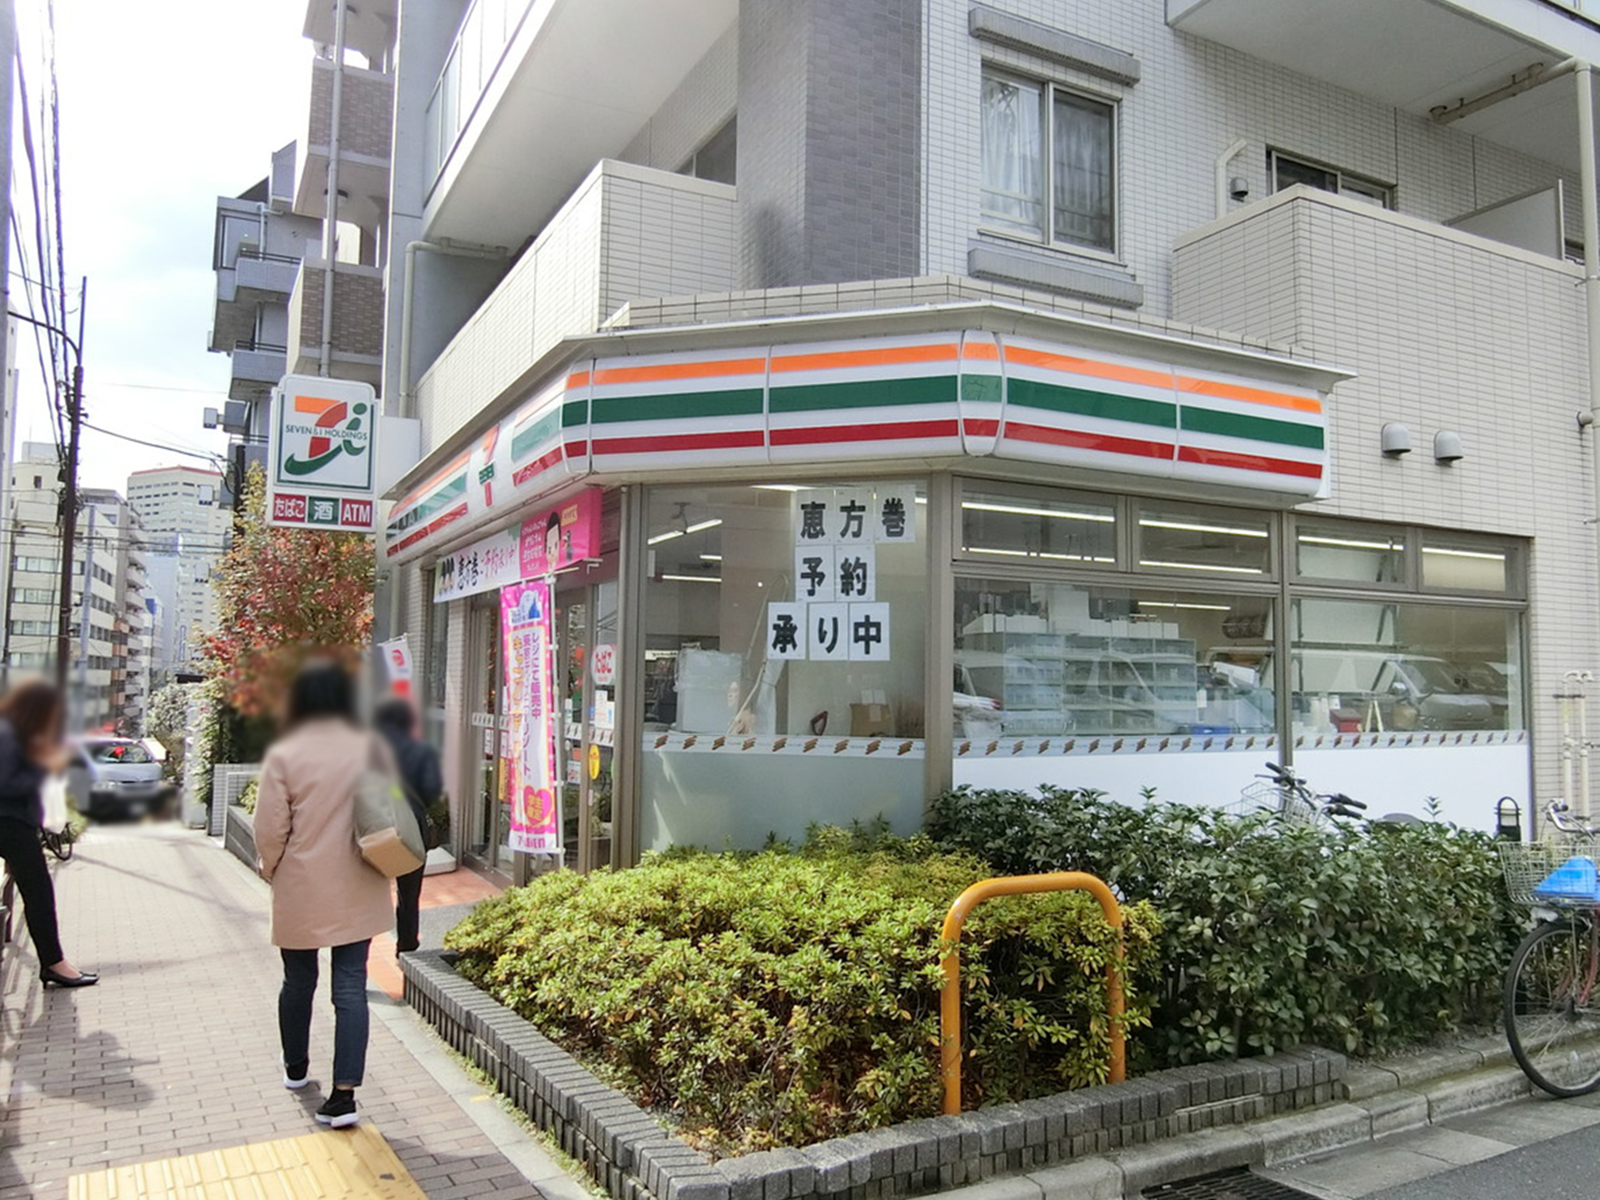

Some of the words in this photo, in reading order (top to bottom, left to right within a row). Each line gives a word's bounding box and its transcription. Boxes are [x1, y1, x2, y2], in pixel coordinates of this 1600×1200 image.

[285, 424, 312, 436] SEVEN
[324, 429, 368, 441] HOLDINGS
[274, 499, 305, 519] たばこ
[313, 501, 334, 521] 酒
[343, 503, 370, 523] ATM
[801, 497, 906, 540] 恵方巻
[801, 557, 867, 596] 予約
[772, 614, 882, 655] 承り中
